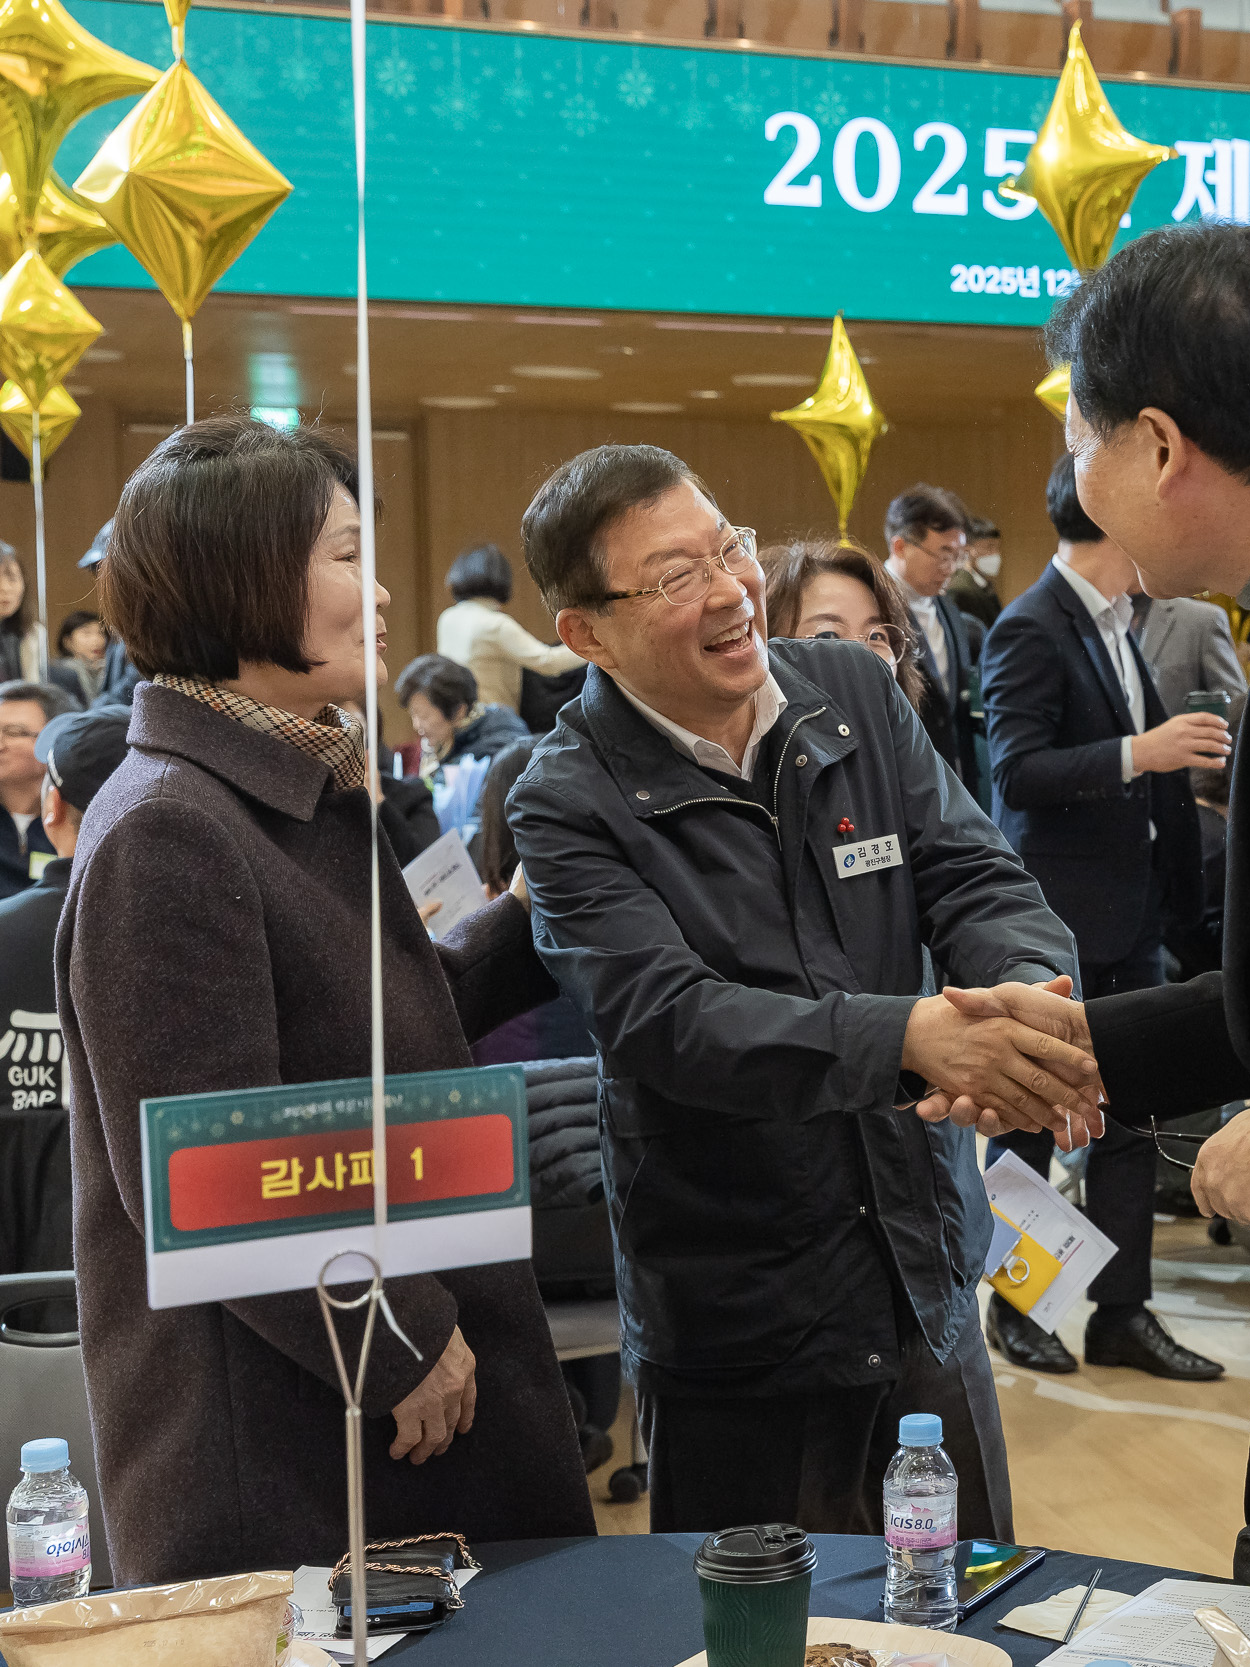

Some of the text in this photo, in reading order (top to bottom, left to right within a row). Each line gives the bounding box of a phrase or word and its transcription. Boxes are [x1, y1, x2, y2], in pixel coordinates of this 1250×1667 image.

[763, 111, 1132, 229] 2025
[950, 264, 1041, 298] 2025년
[857, 840, 894, 859] 김경호
[865, 855, 892, 868] 광진구청장
[8, 1065, 57, 1088] GUK
[11, 1089, 57, 1111] BAP
[410, 1146, 423, 1181] 1
[914, 1518, 934, 1530] 8.0
